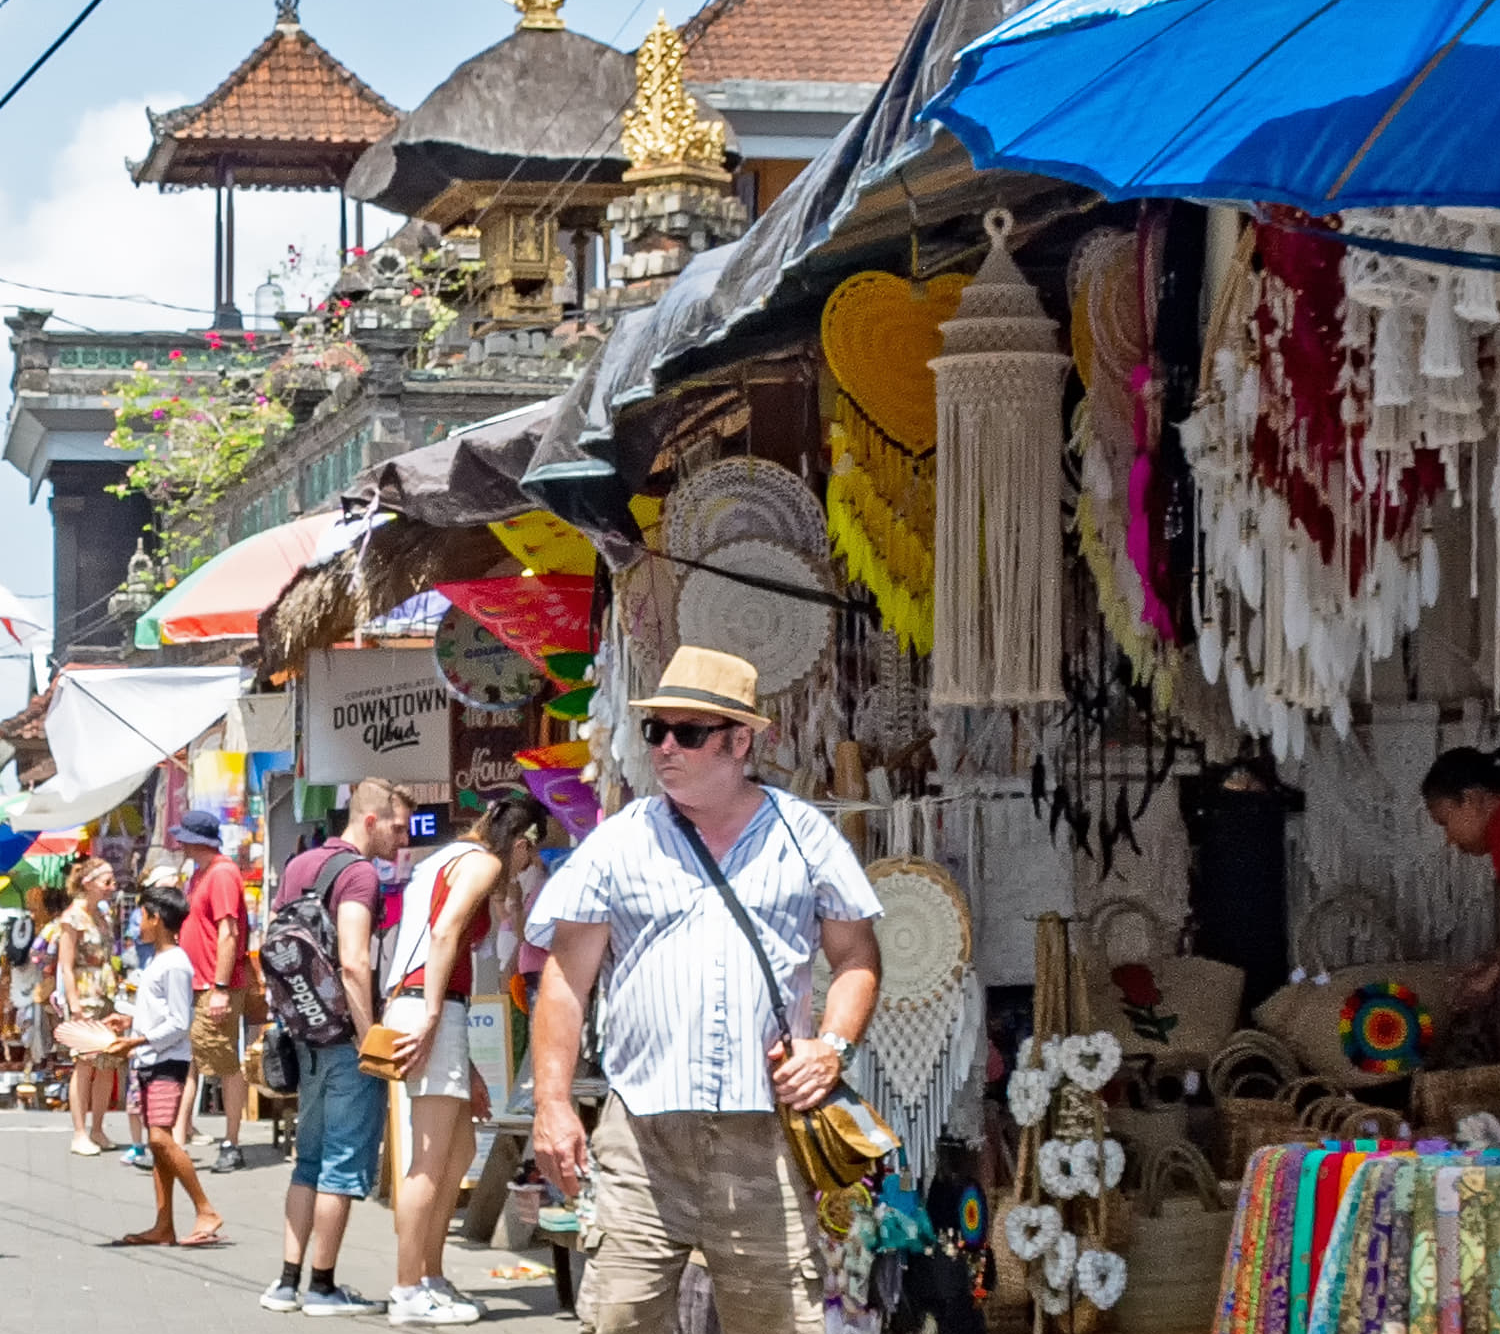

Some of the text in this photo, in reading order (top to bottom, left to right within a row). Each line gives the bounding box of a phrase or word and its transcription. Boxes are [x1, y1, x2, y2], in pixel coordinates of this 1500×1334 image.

[333, 688, 448, 730] DOWNTOWN
[363, 716, 421, 751] Ubud
[410, 814, 435, 835] TE
[284, 975, 328, 1026] adidas
[467, 1015, 494, 1027] ATO
